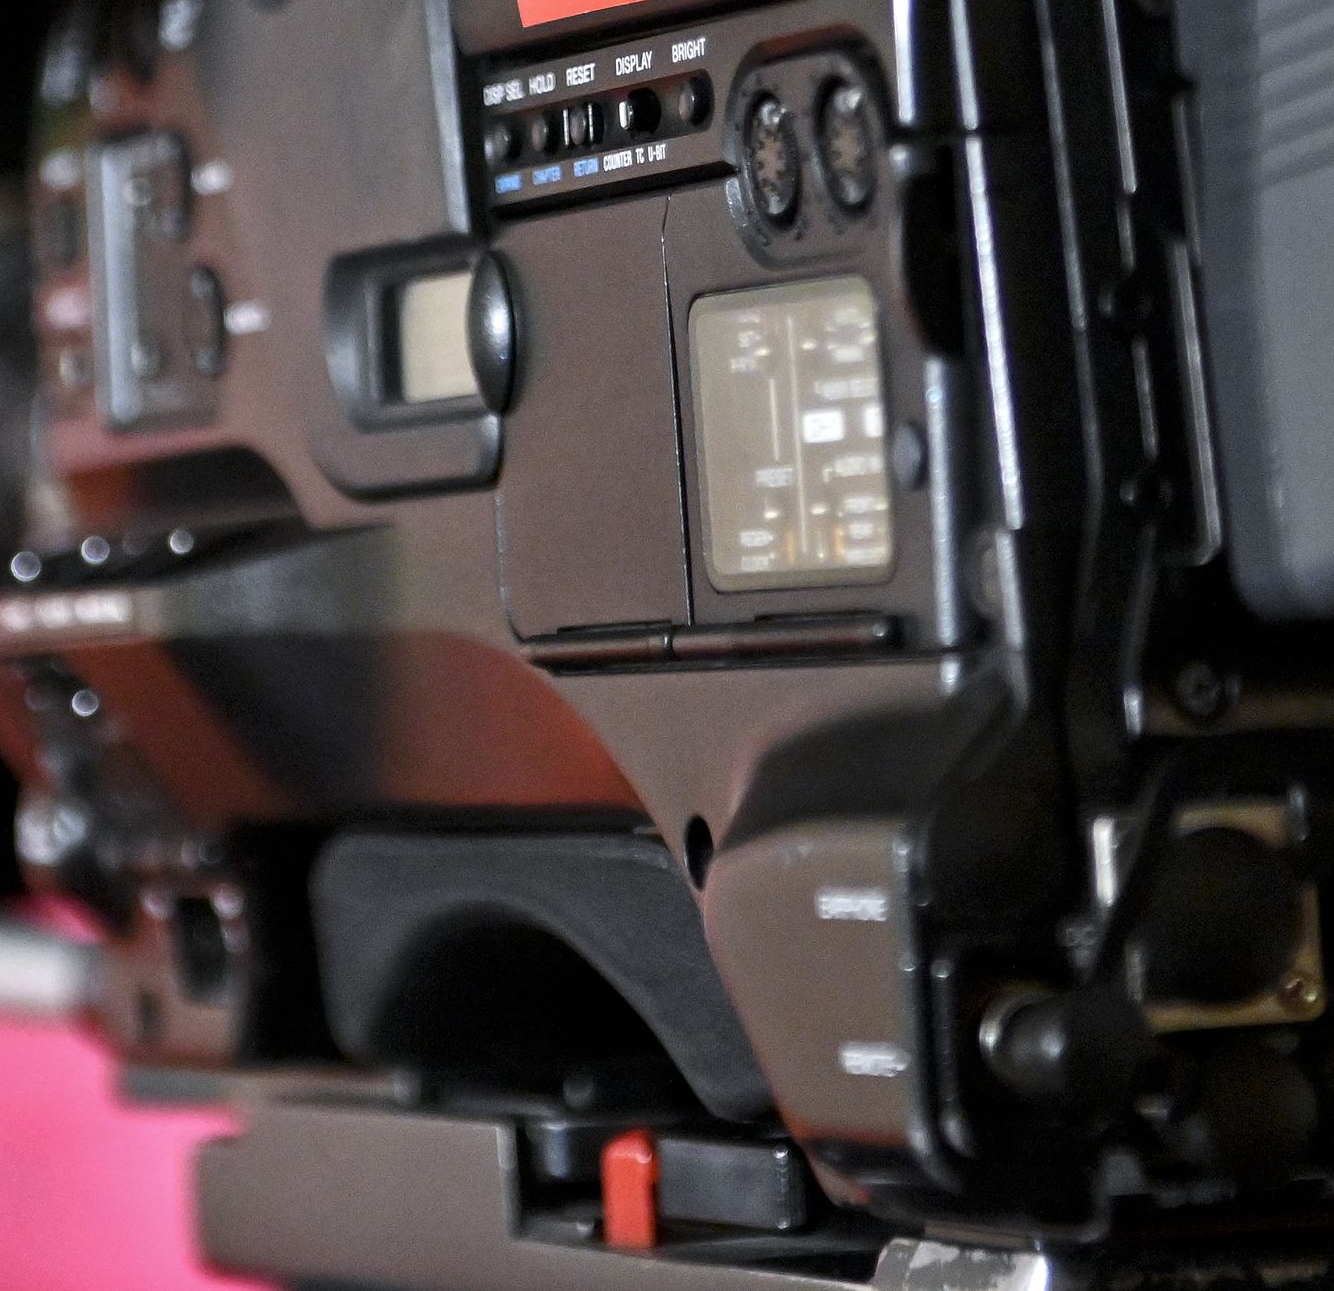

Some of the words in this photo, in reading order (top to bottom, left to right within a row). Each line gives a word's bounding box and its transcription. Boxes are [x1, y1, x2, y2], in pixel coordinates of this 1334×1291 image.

[616, 50, 653, 76] DISPLAY
[671, 37, 706, 63] BRIGHT
[528, 71, 557, 94] HOLD
[566, 63, 596, 87] RESET
[603, 150, 632, 172] COUNTER
[635, 148, 645, 163] TC
[648, 143, 666, 163] U-BIT
